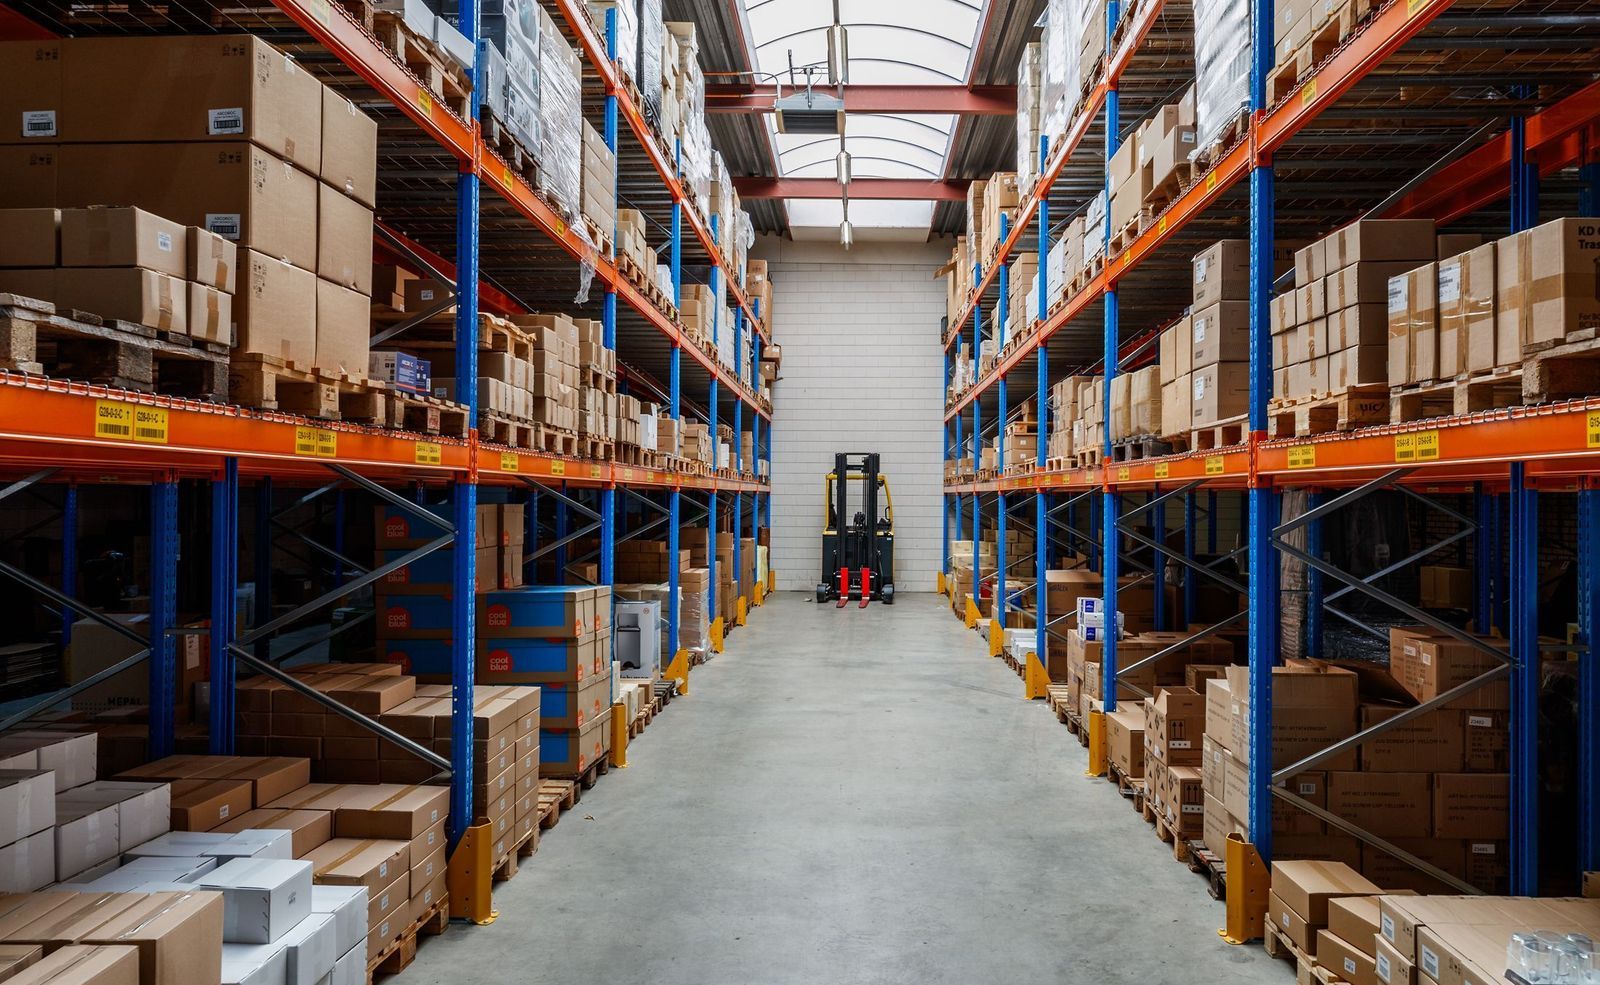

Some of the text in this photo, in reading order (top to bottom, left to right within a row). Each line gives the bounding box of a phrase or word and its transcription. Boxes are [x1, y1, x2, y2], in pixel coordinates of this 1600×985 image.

[1578, 225, 1595, 236] KD
[488, 611, 507, 619] cool
[488, 618, 507, 626] blue
[490, 657, 508, 665] cool
[490, 663, 508, 671] blue
